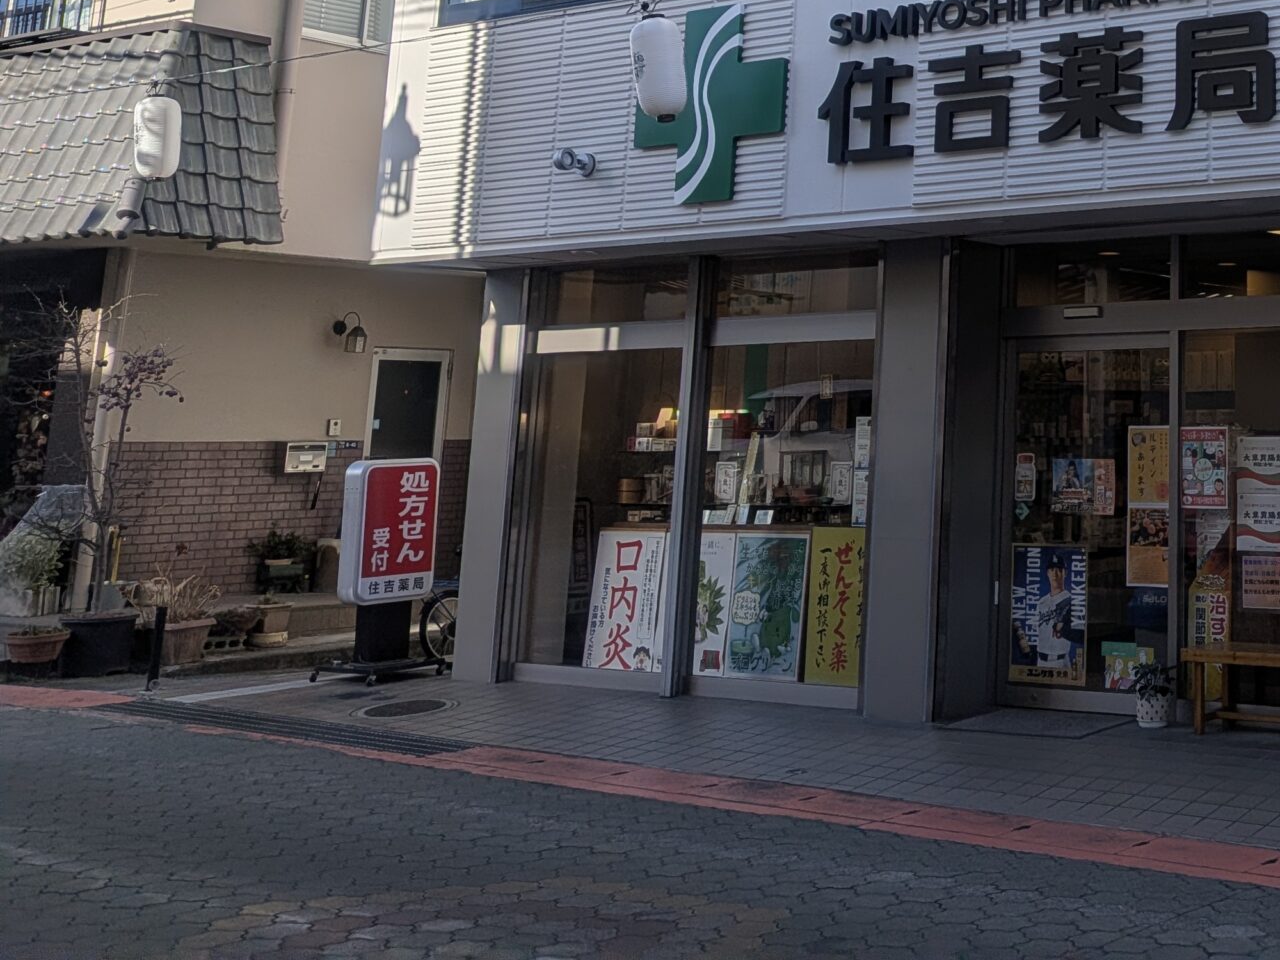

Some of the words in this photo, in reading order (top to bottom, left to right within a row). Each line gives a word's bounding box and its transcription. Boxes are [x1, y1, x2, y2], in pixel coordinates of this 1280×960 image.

[817, 11, 1278, 165] 住吉薬局
[1137, 452, 1145, 497] あります
[1149, 433, 1157, 478] ルテイン
[370, 527, 391, 572] 受付
[396, 471, 430, 563] 処方せん
[368, 576, 425, 596] 住吉薬局
[598, 540, 643, 670] 口内炎
[829, 539, 855, 674] ぜんそく薬
[1012, 586, 1026, 620] NEW
[1026, 547, 1041, 646] GENERATION
